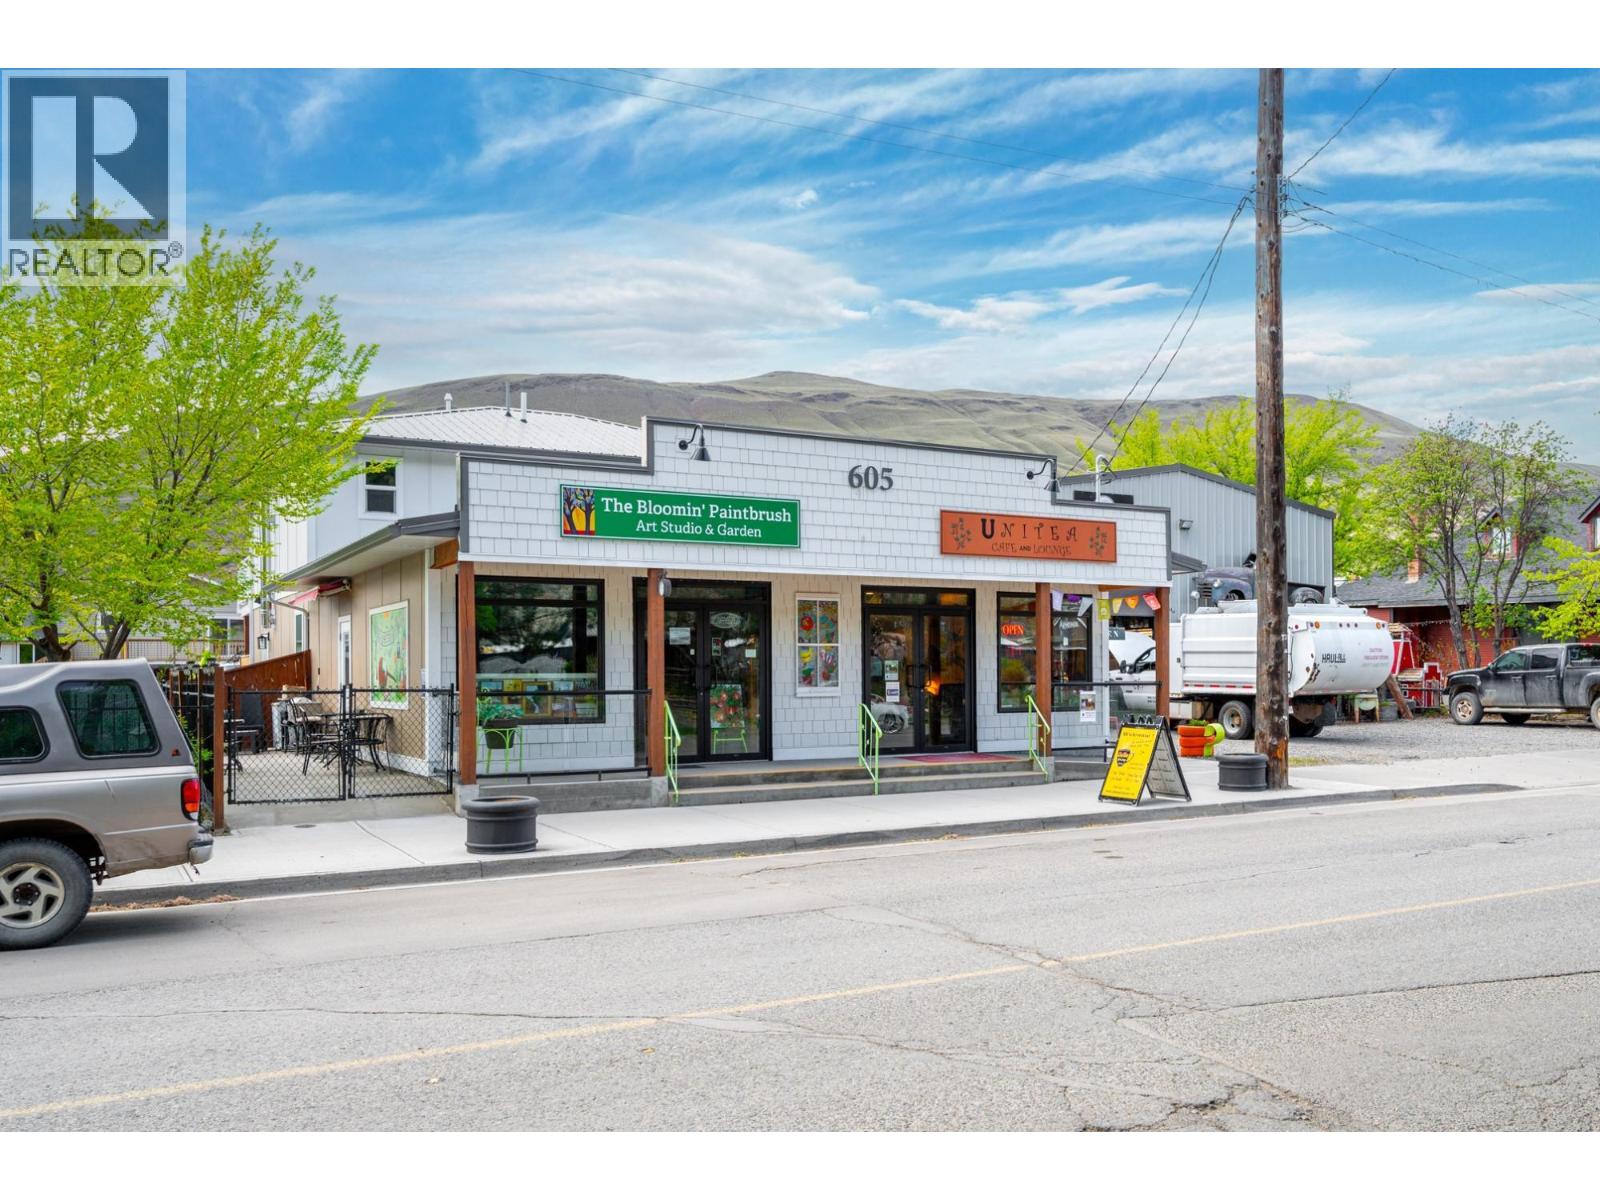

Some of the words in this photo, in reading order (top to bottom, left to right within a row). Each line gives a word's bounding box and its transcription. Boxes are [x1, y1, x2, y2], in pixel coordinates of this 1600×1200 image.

[848, 464, 894, 491] 605
[601, 497, 633, 514] The
[636, 499, 705, 518] Bloomin'
[709, 504, 792, 523] Paintbrush
[635, 520, 657, 533] Art
[660, 520, 702, 535] Studio
[705, 525, 714, 535] &
[717, 523, 762, 538] Garden
[980, 518, 1078, 542] UNITEA
[1002, 624, 1025, 636] OPEN
